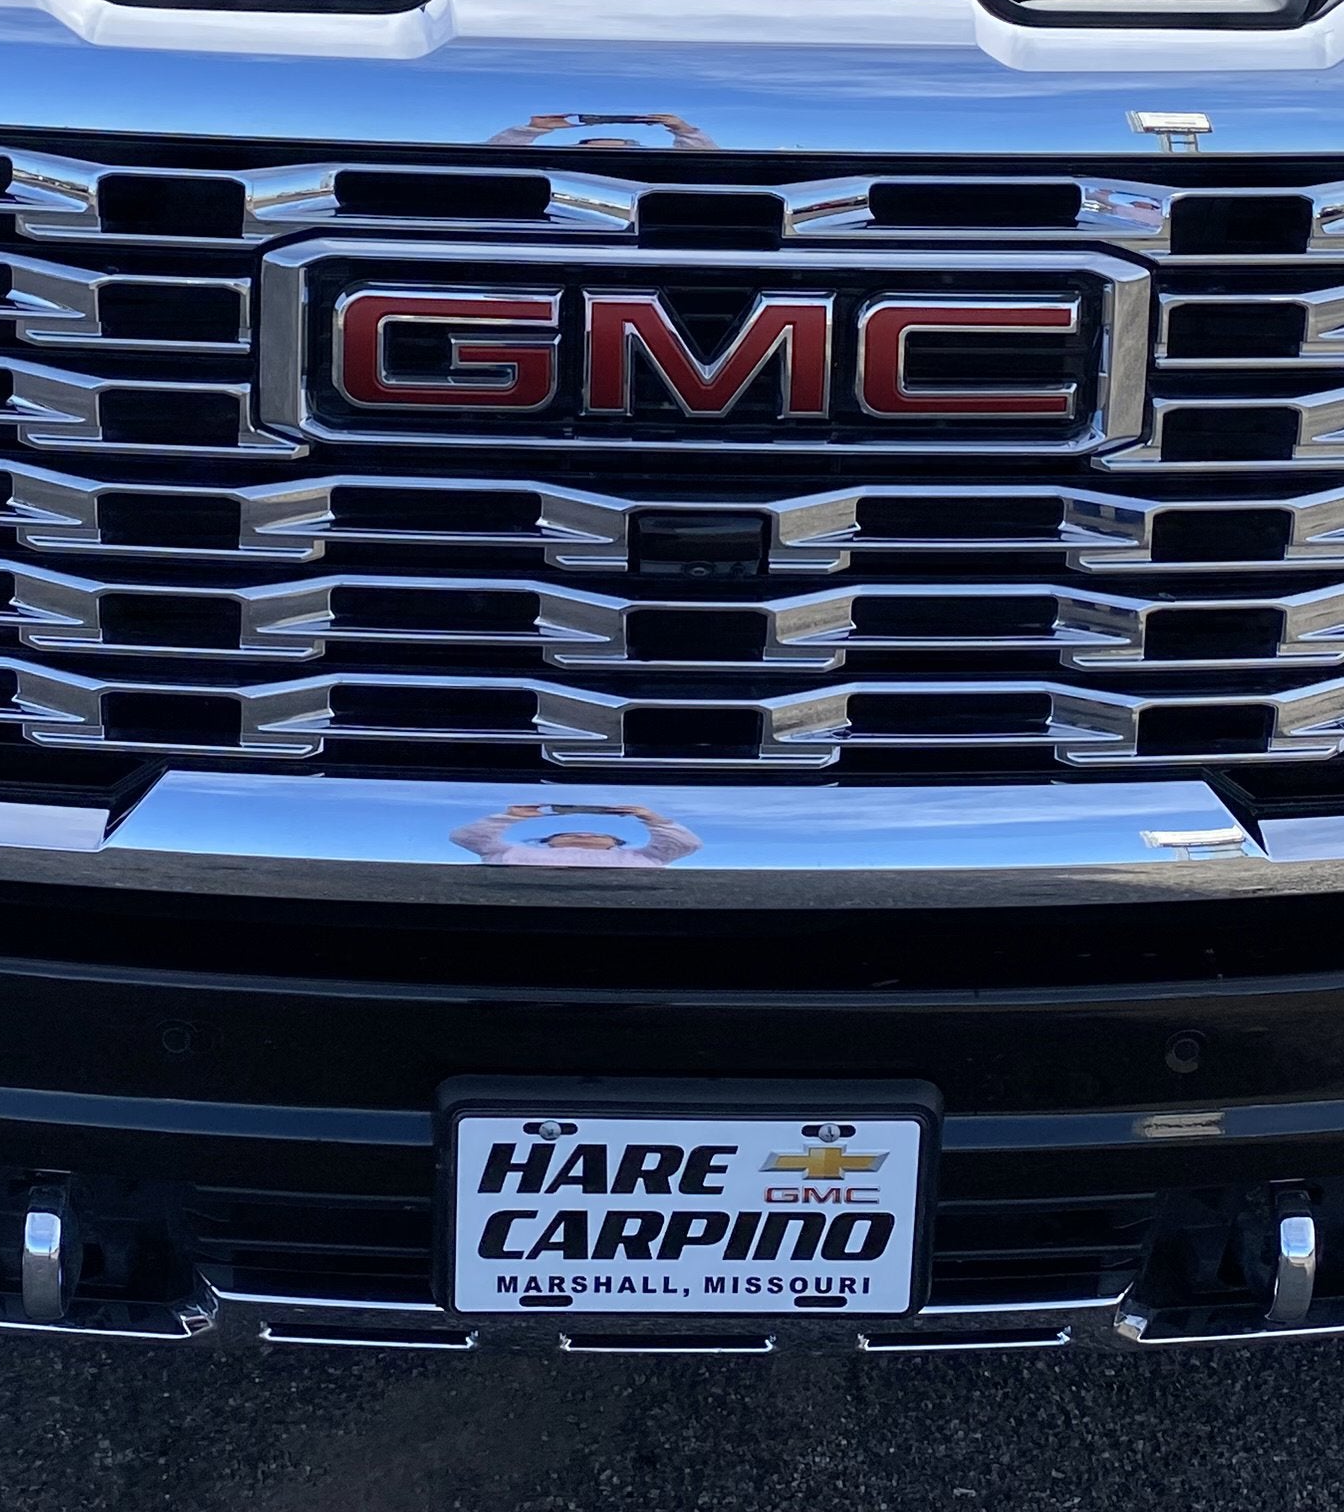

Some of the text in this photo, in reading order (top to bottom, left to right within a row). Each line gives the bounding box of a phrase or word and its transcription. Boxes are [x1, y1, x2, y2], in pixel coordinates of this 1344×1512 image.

[333, 289, 1080, 419] GMC
[477, 1143, 738, 1195] HARE
[763, 1185, 880, 1204] GMC
[477, 1210, 895, 1261] CARPINO
[496, 1275, 870, 1298] MARSHALL, MISSOURI
